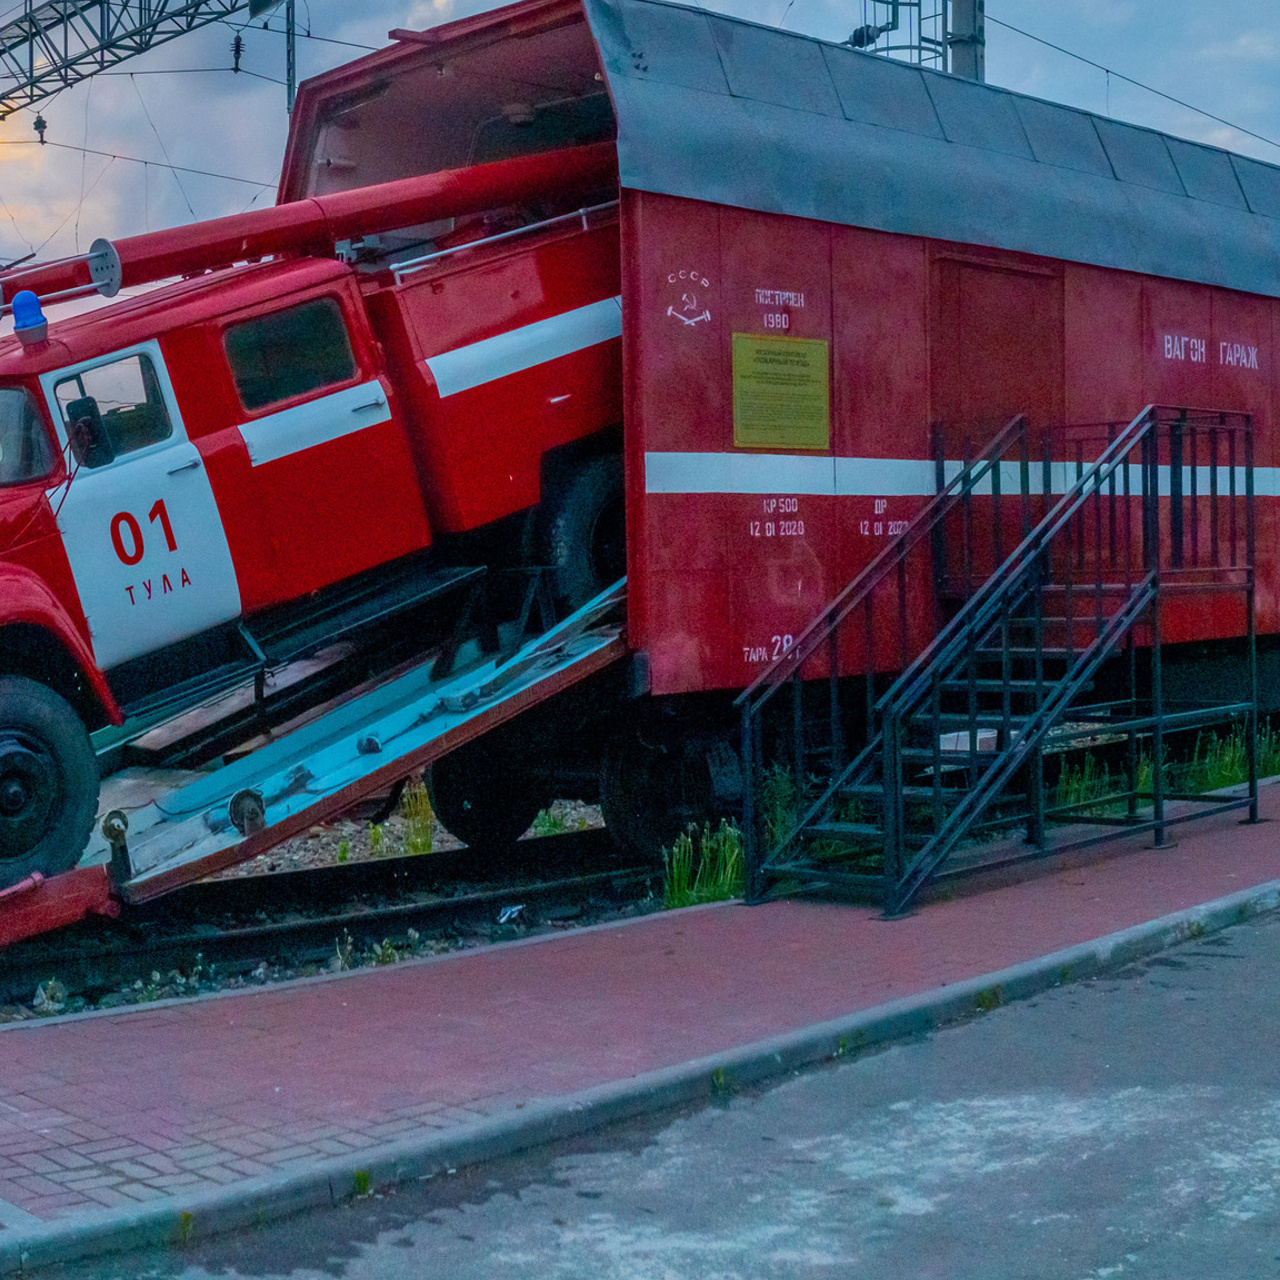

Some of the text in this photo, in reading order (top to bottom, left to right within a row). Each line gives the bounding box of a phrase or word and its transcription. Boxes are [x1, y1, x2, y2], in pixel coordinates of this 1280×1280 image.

[668, 270, 709, 287] СССР
[755, 289, 805, 307] ПОСТРОЕН
[764, 314, 789, 328] 1980
[1164, 335, 1258, 369] ВАГОН ГАРАЖ
[779, 498, 798, 513] 500
[110, 498, 178, 566] 01
[750, 522, 761, 536] 12
[779, 521, 804, 535] 2020
[860, 521, 869, 535] 12
[125, 568, 191, 605] ТУЛА
[743, 647, 768, 662] ТАРА
